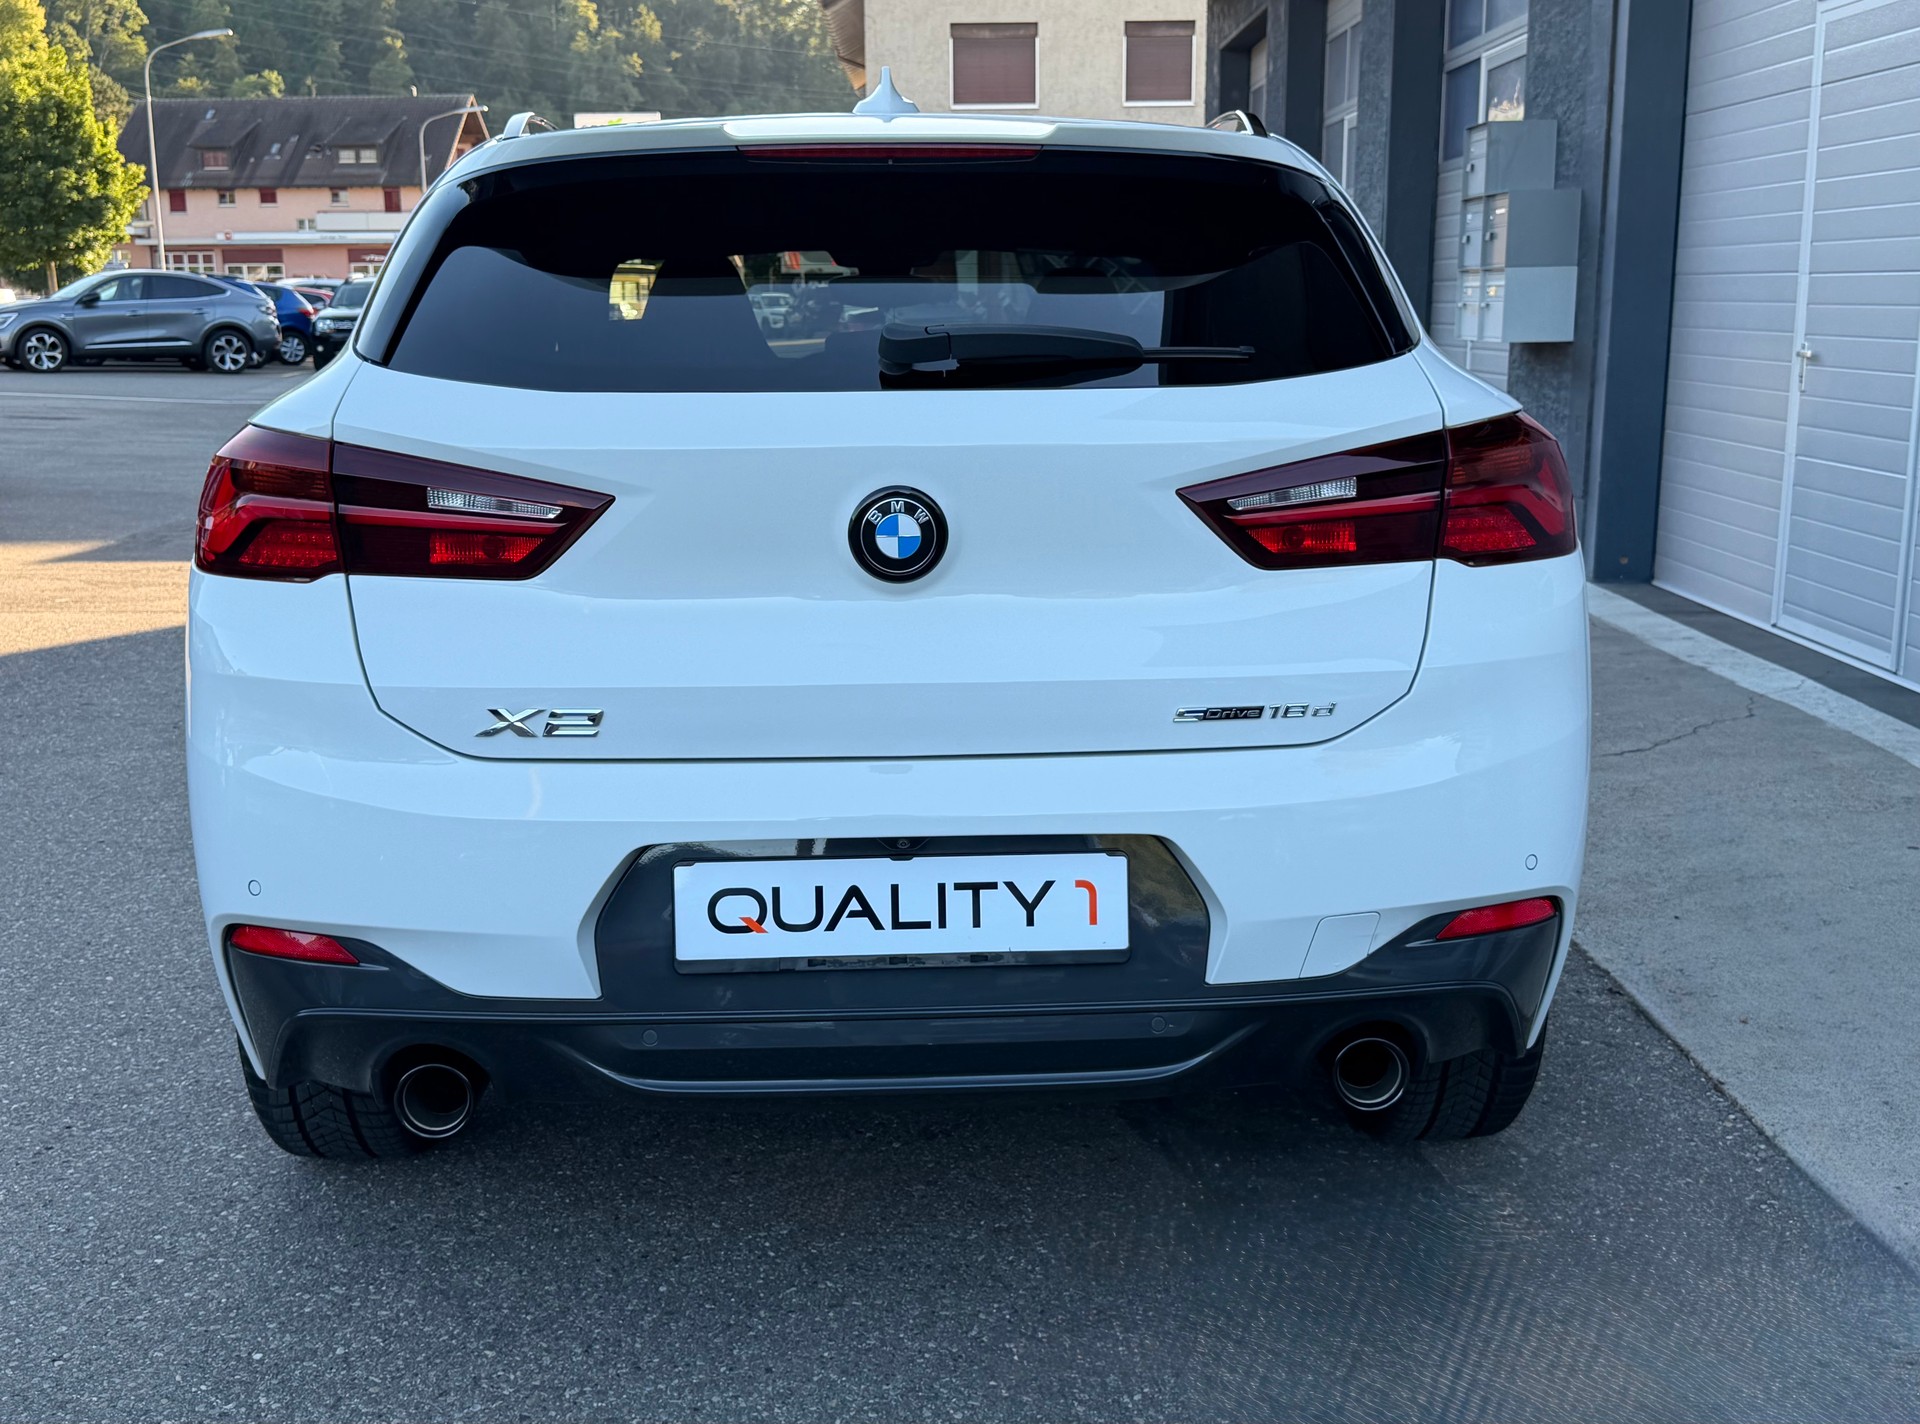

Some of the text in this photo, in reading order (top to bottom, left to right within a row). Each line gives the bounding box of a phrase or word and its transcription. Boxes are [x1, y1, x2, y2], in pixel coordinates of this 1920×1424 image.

[867, 500, 930, 525] BMW
[474, 707, 604, 737] X2
[707, 879, 1098, 934] QUALITY 1
